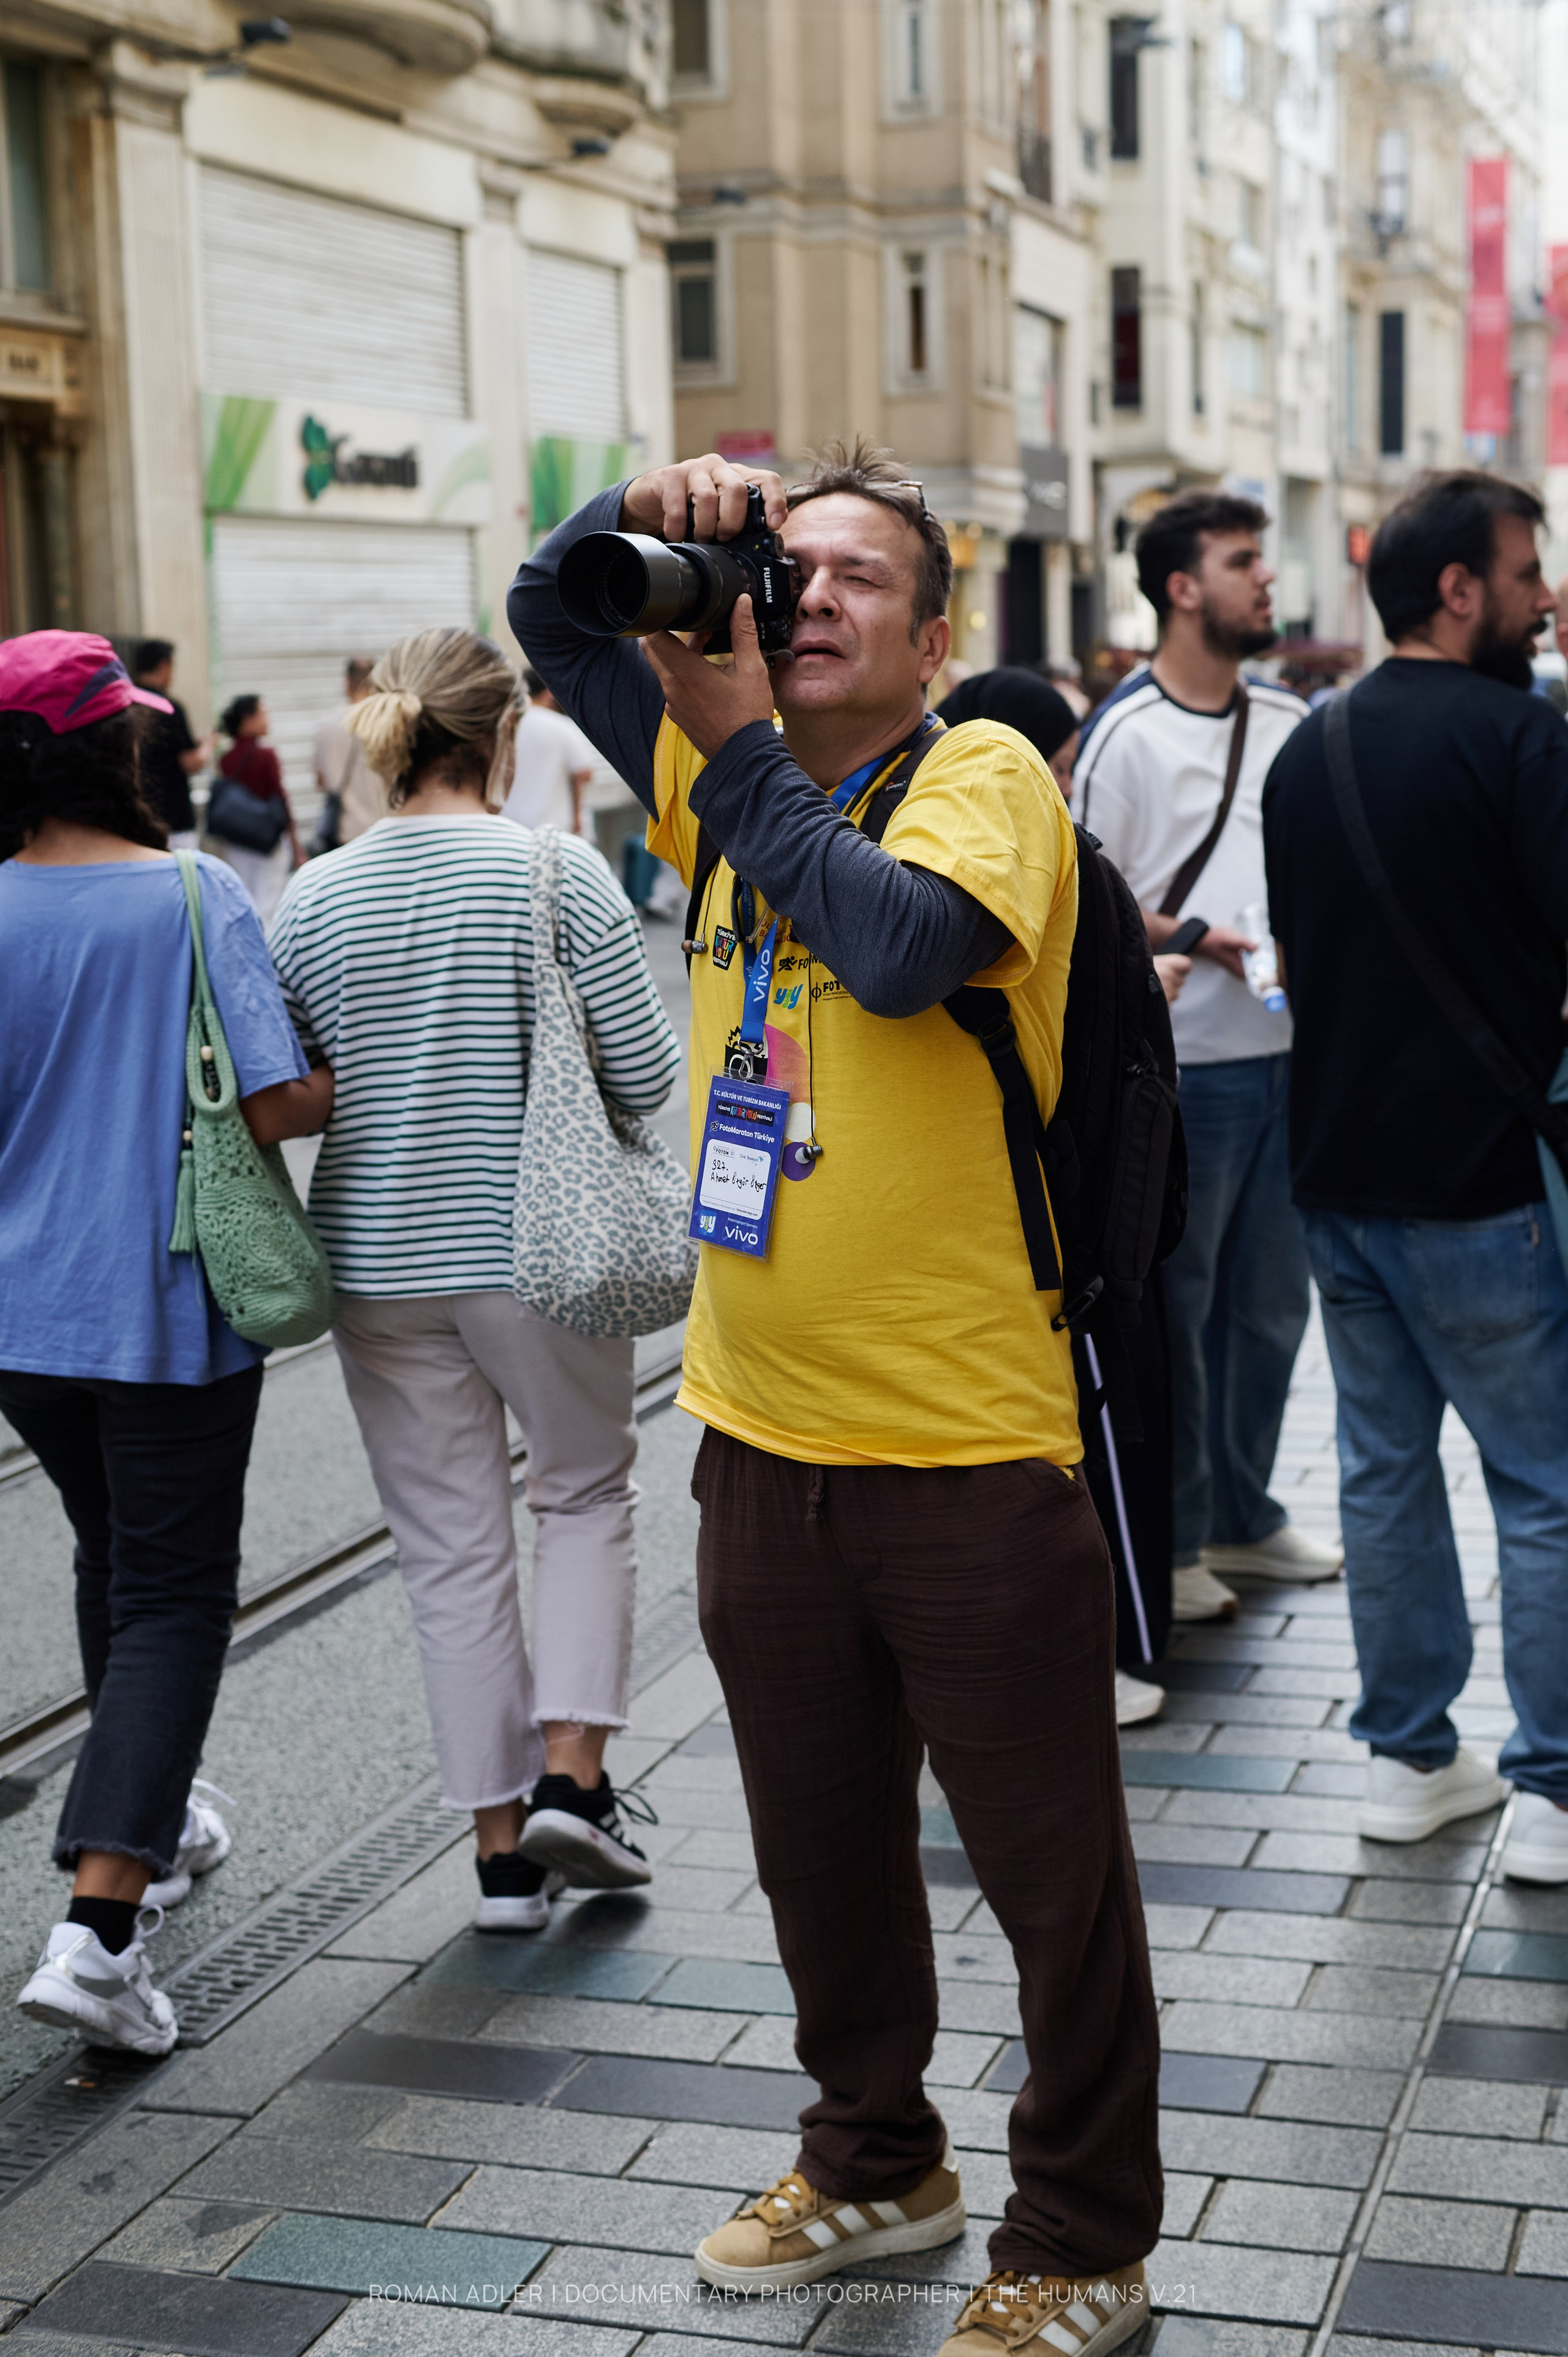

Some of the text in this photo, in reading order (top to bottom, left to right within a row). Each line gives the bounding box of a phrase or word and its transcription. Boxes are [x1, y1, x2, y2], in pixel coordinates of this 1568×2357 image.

[763, 567, 772, 603] FUJIFILM
[753, 949, 770, 1002] vivo
[823, 981, 840, 992] FOT
[721, 1091, 737, 1100] KÜLTÜR
[743, 1096, 758, 1105] TURİZM
[758, 1099, 782, 1110] BAKANLIĞI
[719, 1124, 775, 1144] FotoMaraton Türkiye
[725, 1226, 758, 1245] vivo
